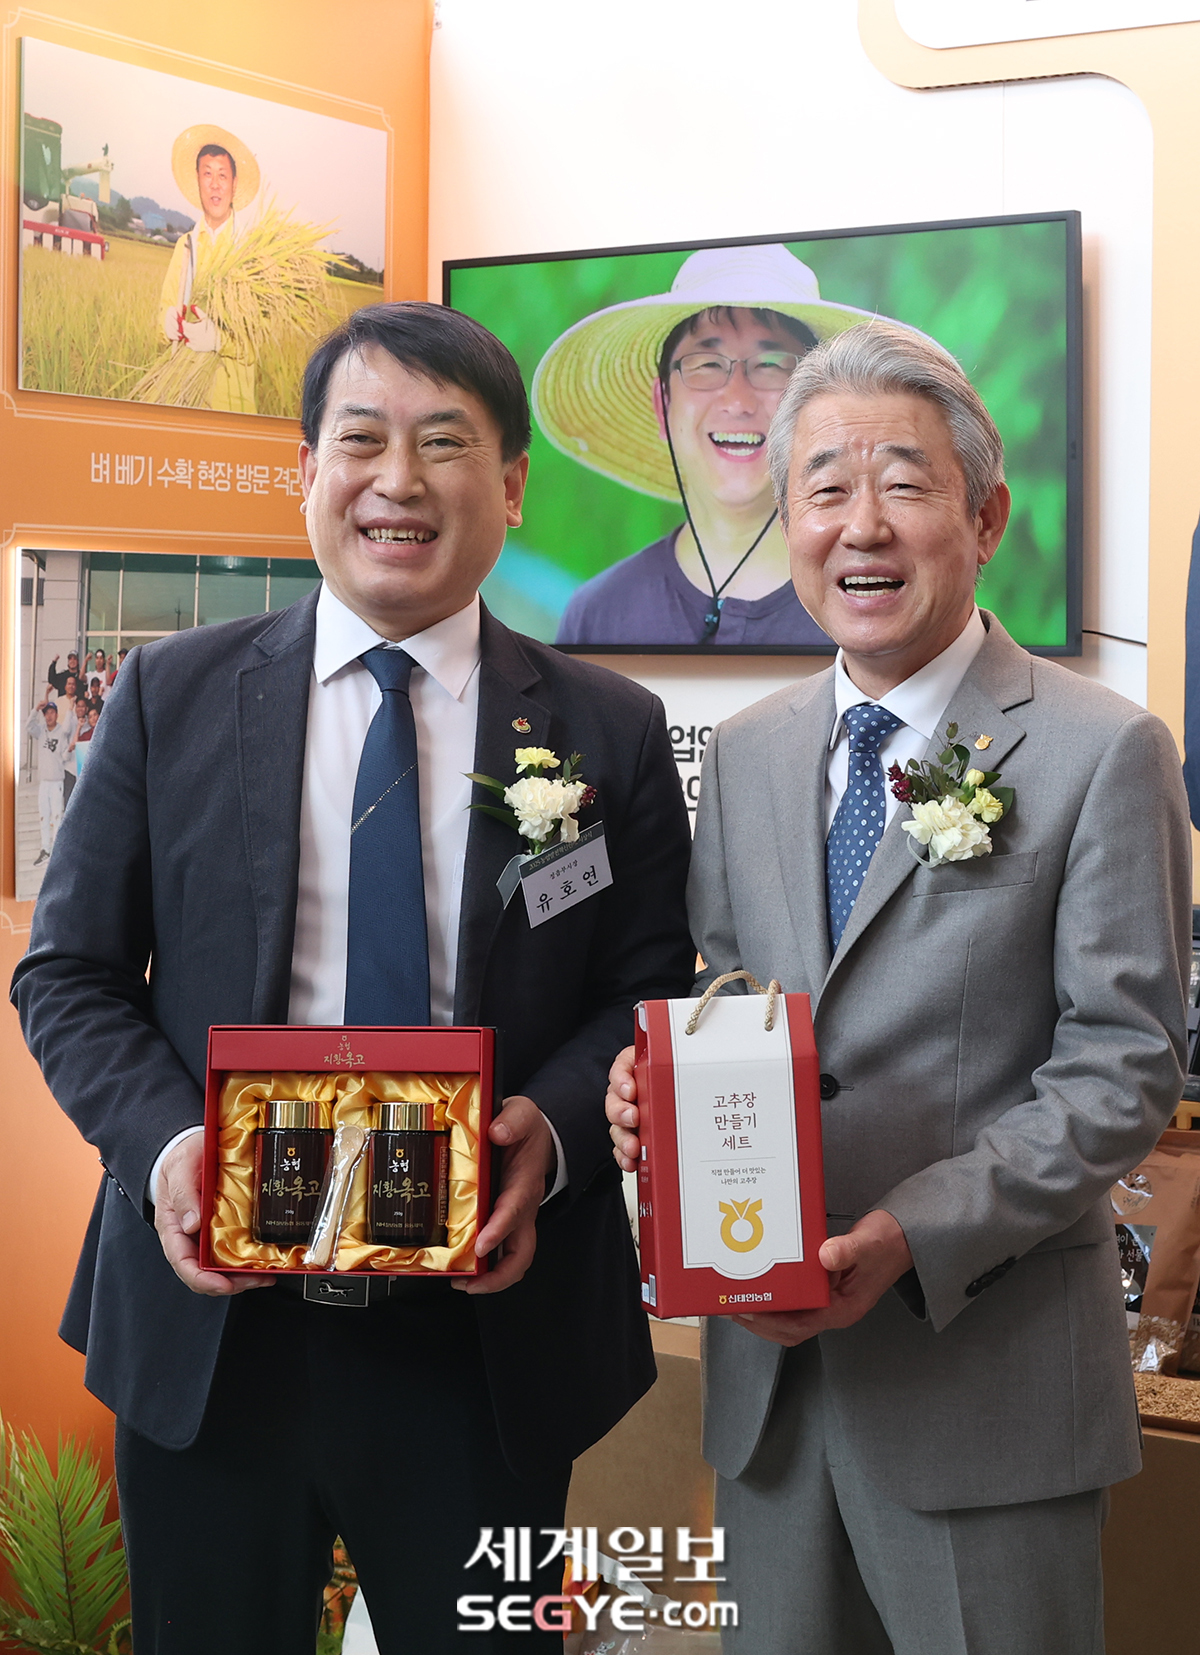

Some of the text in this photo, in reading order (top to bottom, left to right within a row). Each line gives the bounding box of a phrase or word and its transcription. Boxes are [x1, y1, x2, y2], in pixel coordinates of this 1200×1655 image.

[91, 452, 110, 484] 벼
[115, 453, 153, 487] 베기
[156, 458, 195, 489] 수확
[197, 460, 234, 492] 현장
[236, 463, 270, 495] 방문
[713, 1091, 757, 1109] 고추장
[714, 1112, 757, 1131] 만들기
[722, 1134, 753, 1151] 세트
[280, 1158, 301, 1172] 농협
[388, 1159, 410, 1173] 농협
[711, 1166, 767, 1177] 직접 만들어 더 맛있는
[262, 1175, 322, 1203] 지황옥고
[720, 1176, 758, 1186] 나만의 고추장
[372, 1177, 432, 1205] 지황옥고
[728, 1292, 773, 1304] 신태인농협
